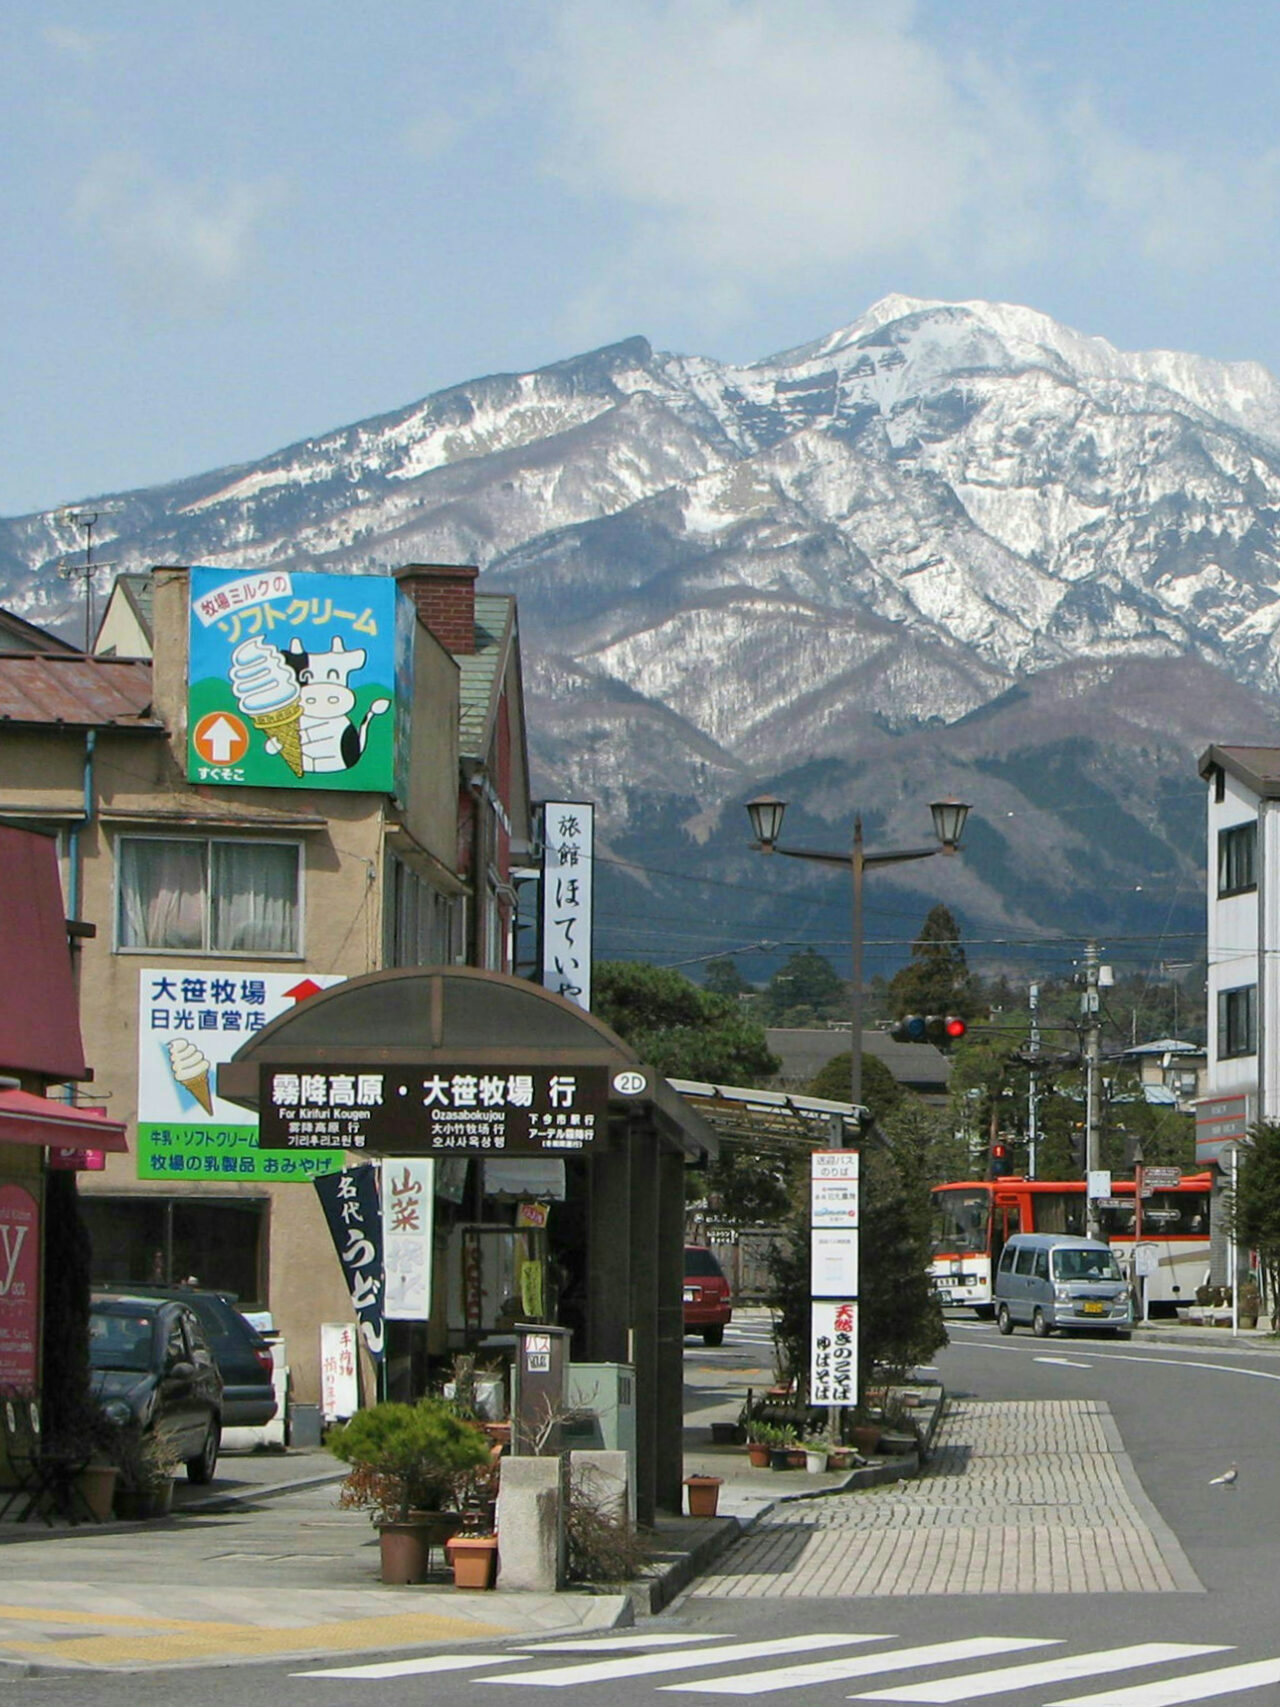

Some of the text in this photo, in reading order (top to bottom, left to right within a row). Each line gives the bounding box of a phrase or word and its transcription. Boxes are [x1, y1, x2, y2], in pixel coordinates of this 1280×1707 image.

[201, 576, 288, 617] 牧場ミルクの
[217, 598, 377, 643] ソフトクリーム
[198, 767, 246, 782] すぐそこ
[554, 815, 583, 998] 旅館ほていや
[152, 977, 266, 1005] 大笹牧場
[151, 1009, 266, 1032] 日光直営店
[549, 1076, 577, 1107] 行
[621, 1075, 643, 1091] 2D
[279, 1108, 371, 1122] For Kirifuri Kougen
[431, 1109, 505, 1122] Ozasabokujou
[347, 1121, 360, 1134] 行
[493, 1123, 505, 1135] 行
[151, 1130, 259, 1149] 牛乳・ソフトクリーム
[151, 1155, 332, 1174] 牧場の乳製品 おみやげ
[820, 1167, 848, 1177] のりば
[391, 1166, 422, 1231] 山菜
[524, 1334, 550, 1351] バス
[833, 1304, 854, 1400] 天然きのこそば
[814, 1335, 831, 1400] ゆばそば
